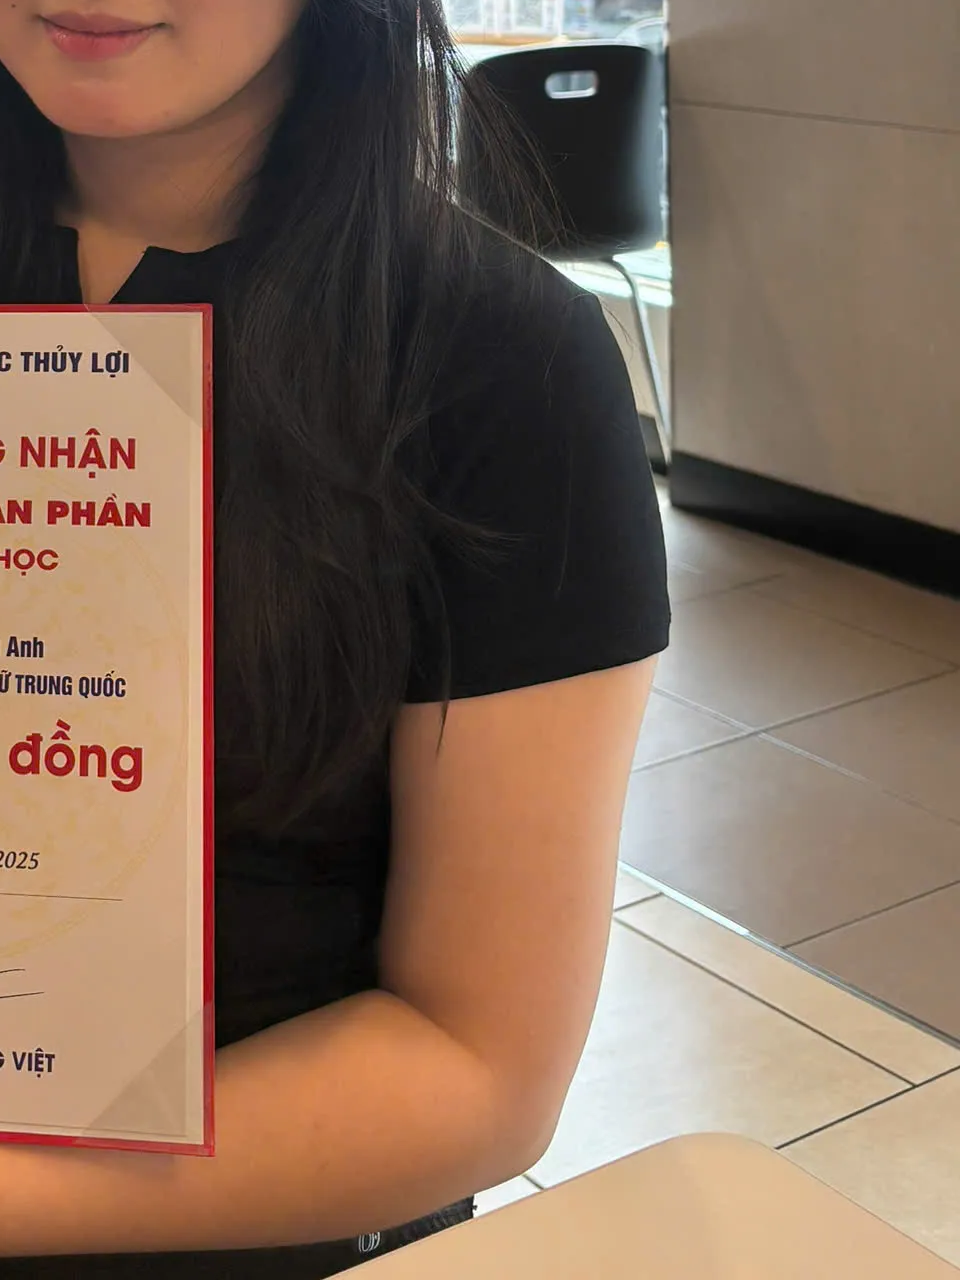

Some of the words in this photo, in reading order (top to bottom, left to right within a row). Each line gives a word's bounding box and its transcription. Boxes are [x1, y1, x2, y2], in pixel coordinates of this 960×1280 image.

[21, 345, 82, 372] THỦY
[92, 351, 129, 378] LỢI
[20, 428, 135, 478] NHẬN
[47, 493, 150, 527] PHẦN
[6, 636, 43, 658] Anh
[15, 675, 72, 695] TRUNG
[79, 671, 126, 698] QUỐC
[9, 719, 142, 792] đồng
[13, 1048, 55, 1078] VIỆT
